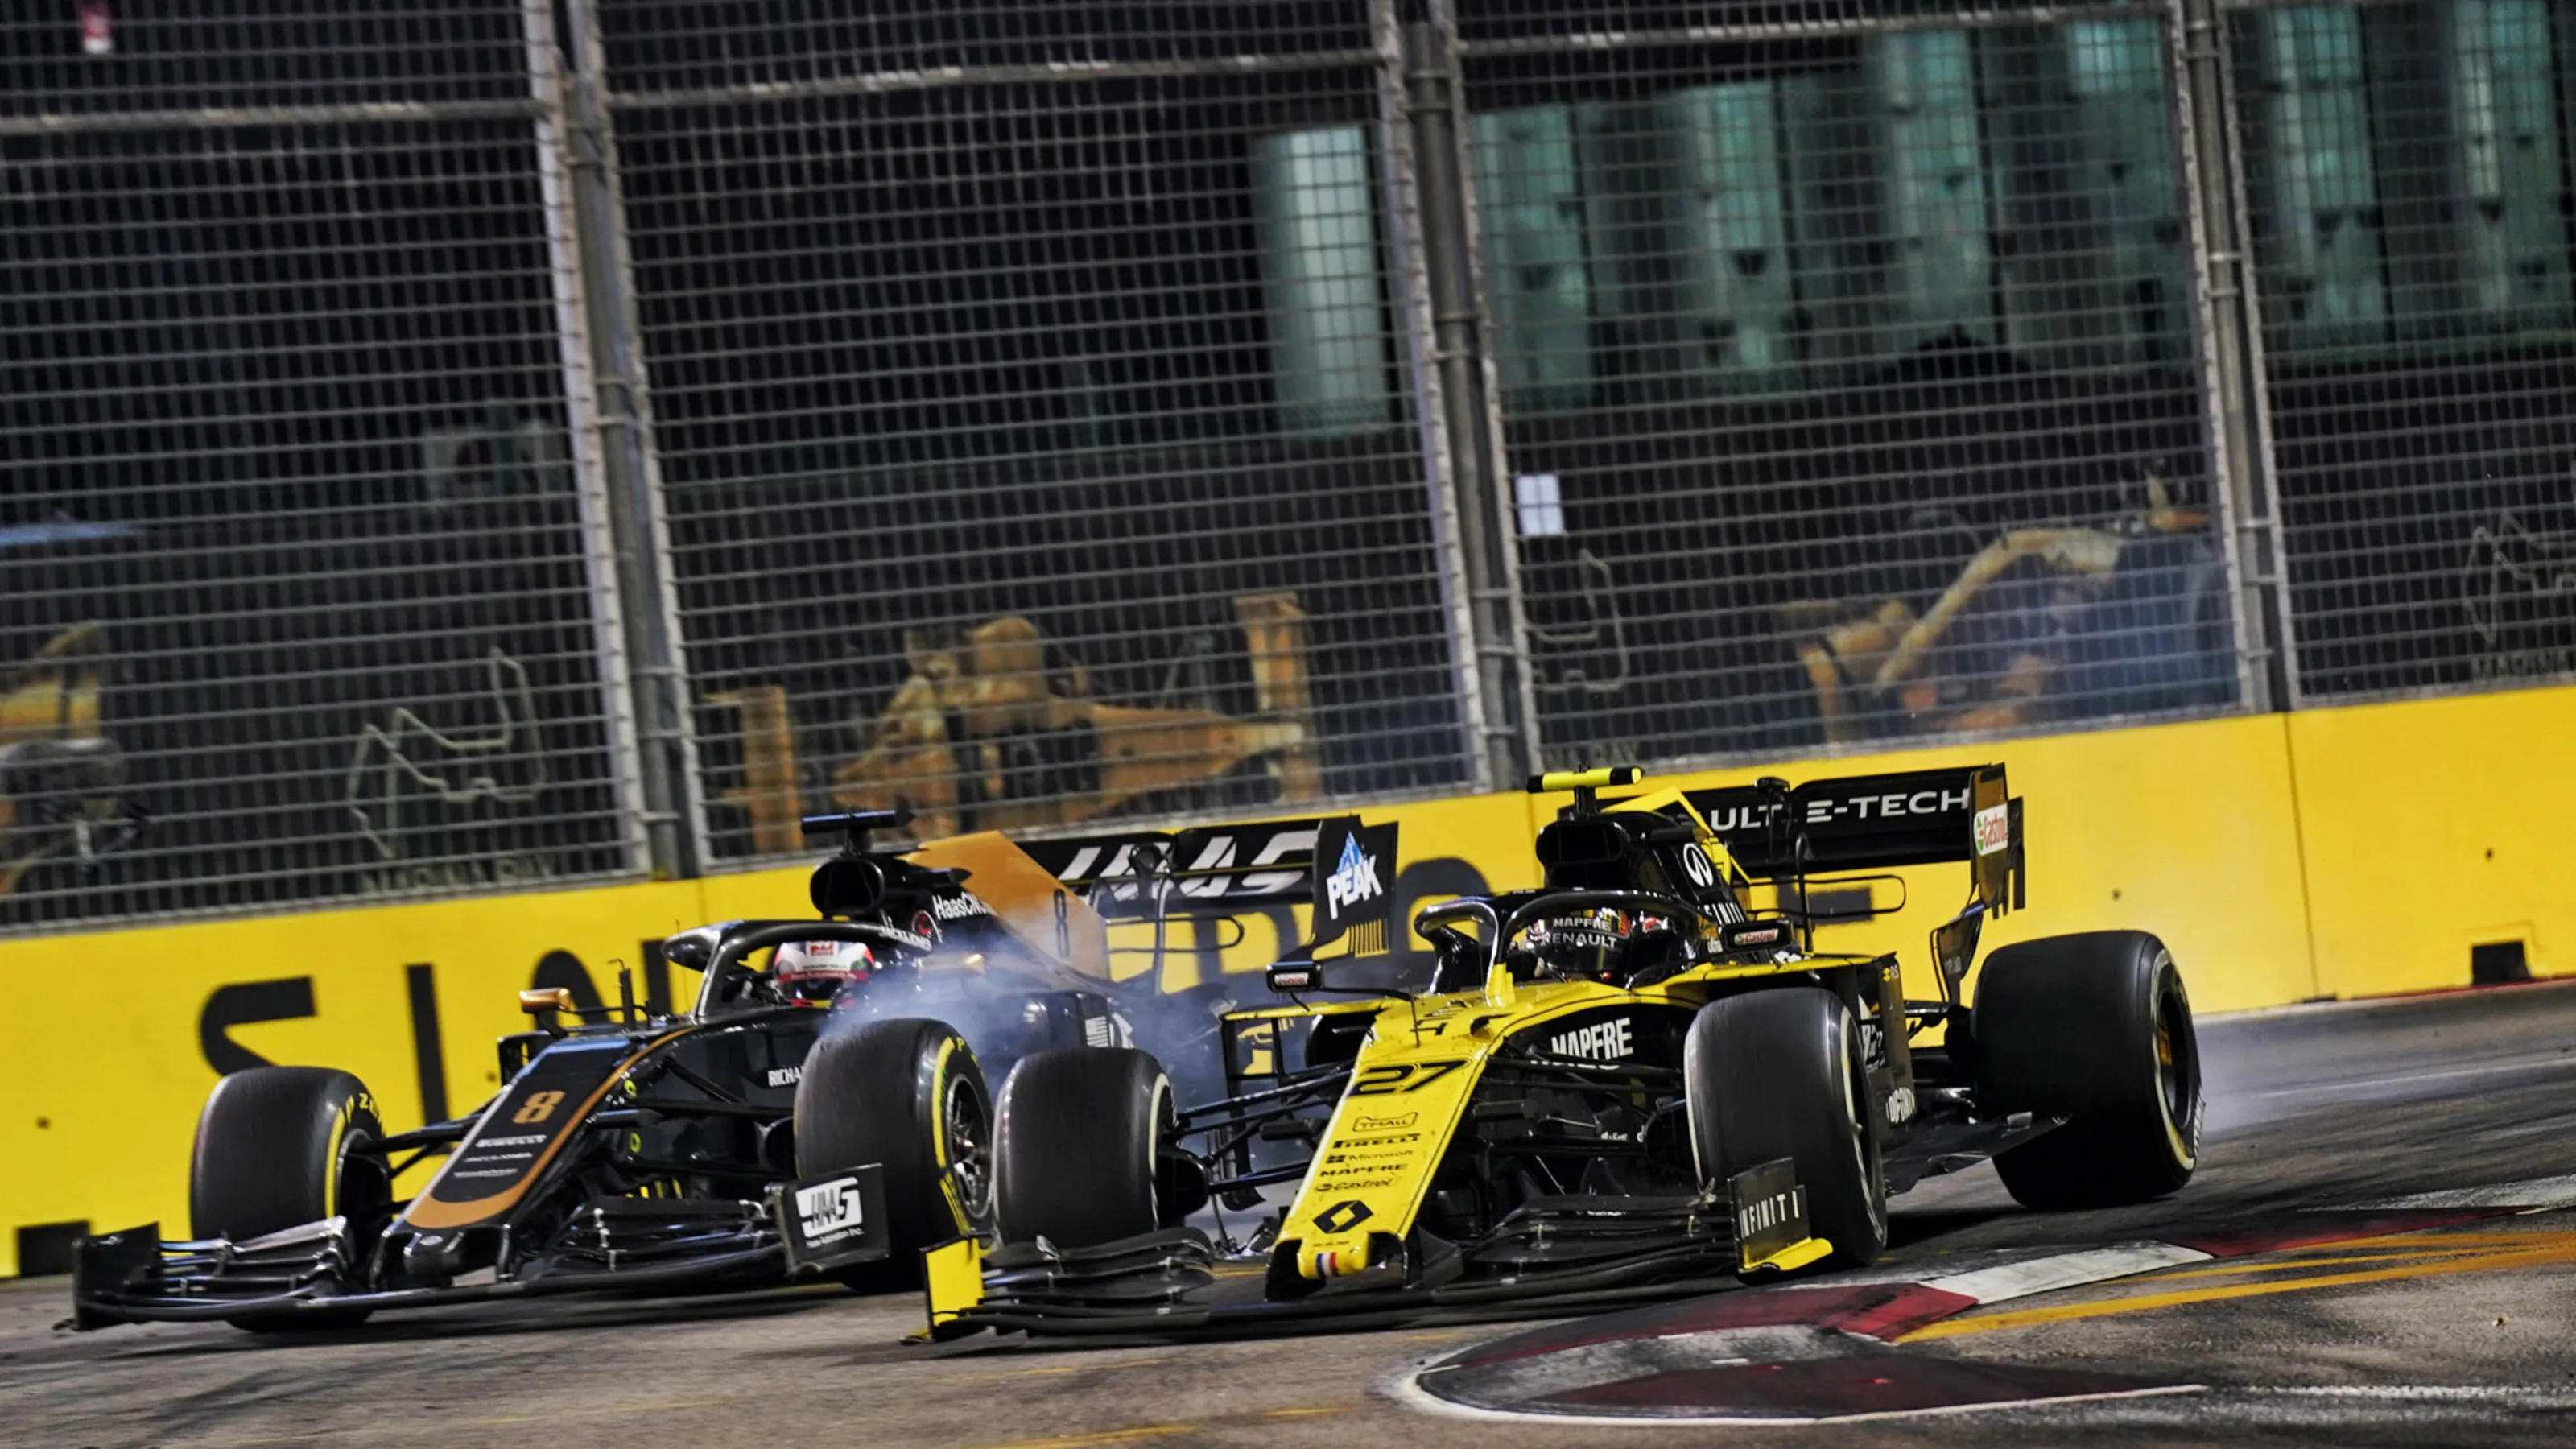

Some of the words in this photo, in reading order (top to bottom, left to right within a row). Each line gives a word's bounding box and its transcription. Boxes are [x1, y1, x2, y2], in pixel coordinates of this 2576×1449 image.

[1806, 789, 1970, 823] E-TECH
[1327, 855, 1383, 920] PEAK
[1552, 916, 1611, 931] MAPFRE
[1744, 929, 1776, 943] Castrol
[1540, 931, 1618, 950] RENAULT
[1550, 1017, 1634, 1061] MAPFRE
[1347, 1059, 1468, 1096] 27
[512, 1091, 566, 1124] 8
[1333, 1133, 1421, 1149] PIRELLI
[1319, 1164, 1408, 1177] MAPFRE
[1738, 1191, 1800, 1240] INFINITI
